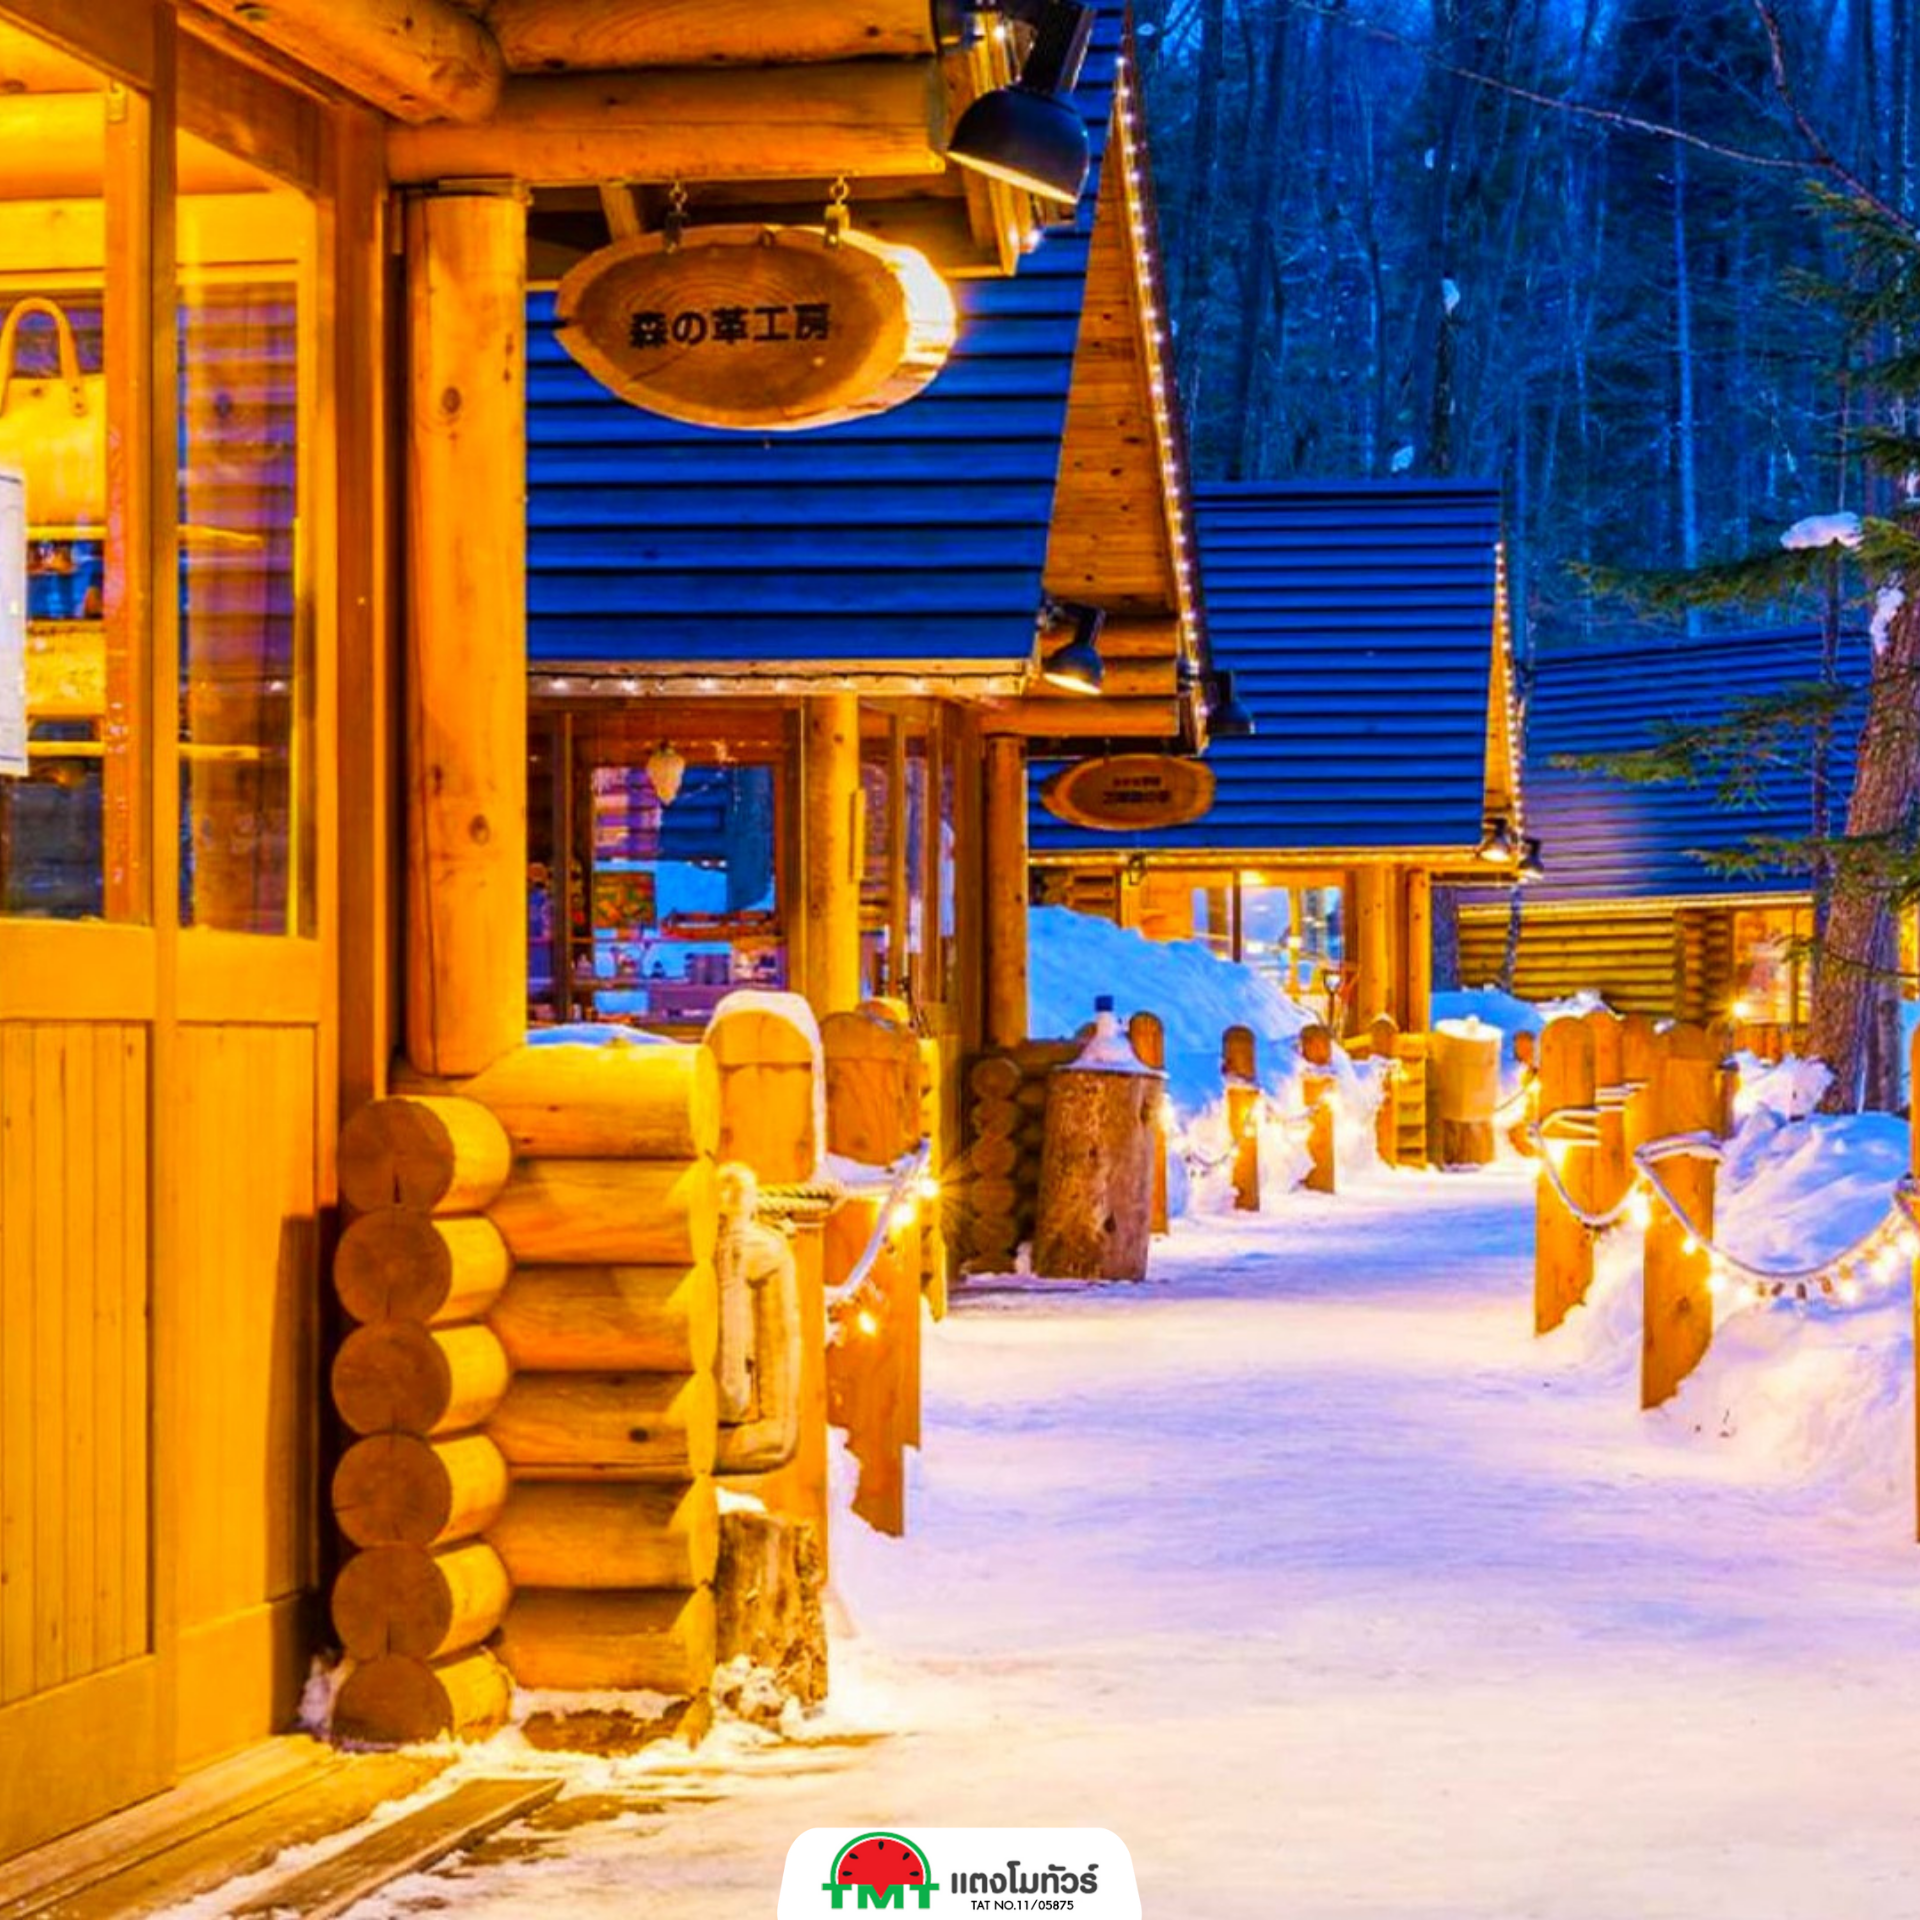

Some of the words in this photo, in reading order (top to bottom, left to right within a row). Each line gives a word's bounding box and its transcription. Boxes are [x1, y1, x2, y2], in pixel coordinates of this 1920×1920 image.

[630, 303, 831, 349] 森の革工房
